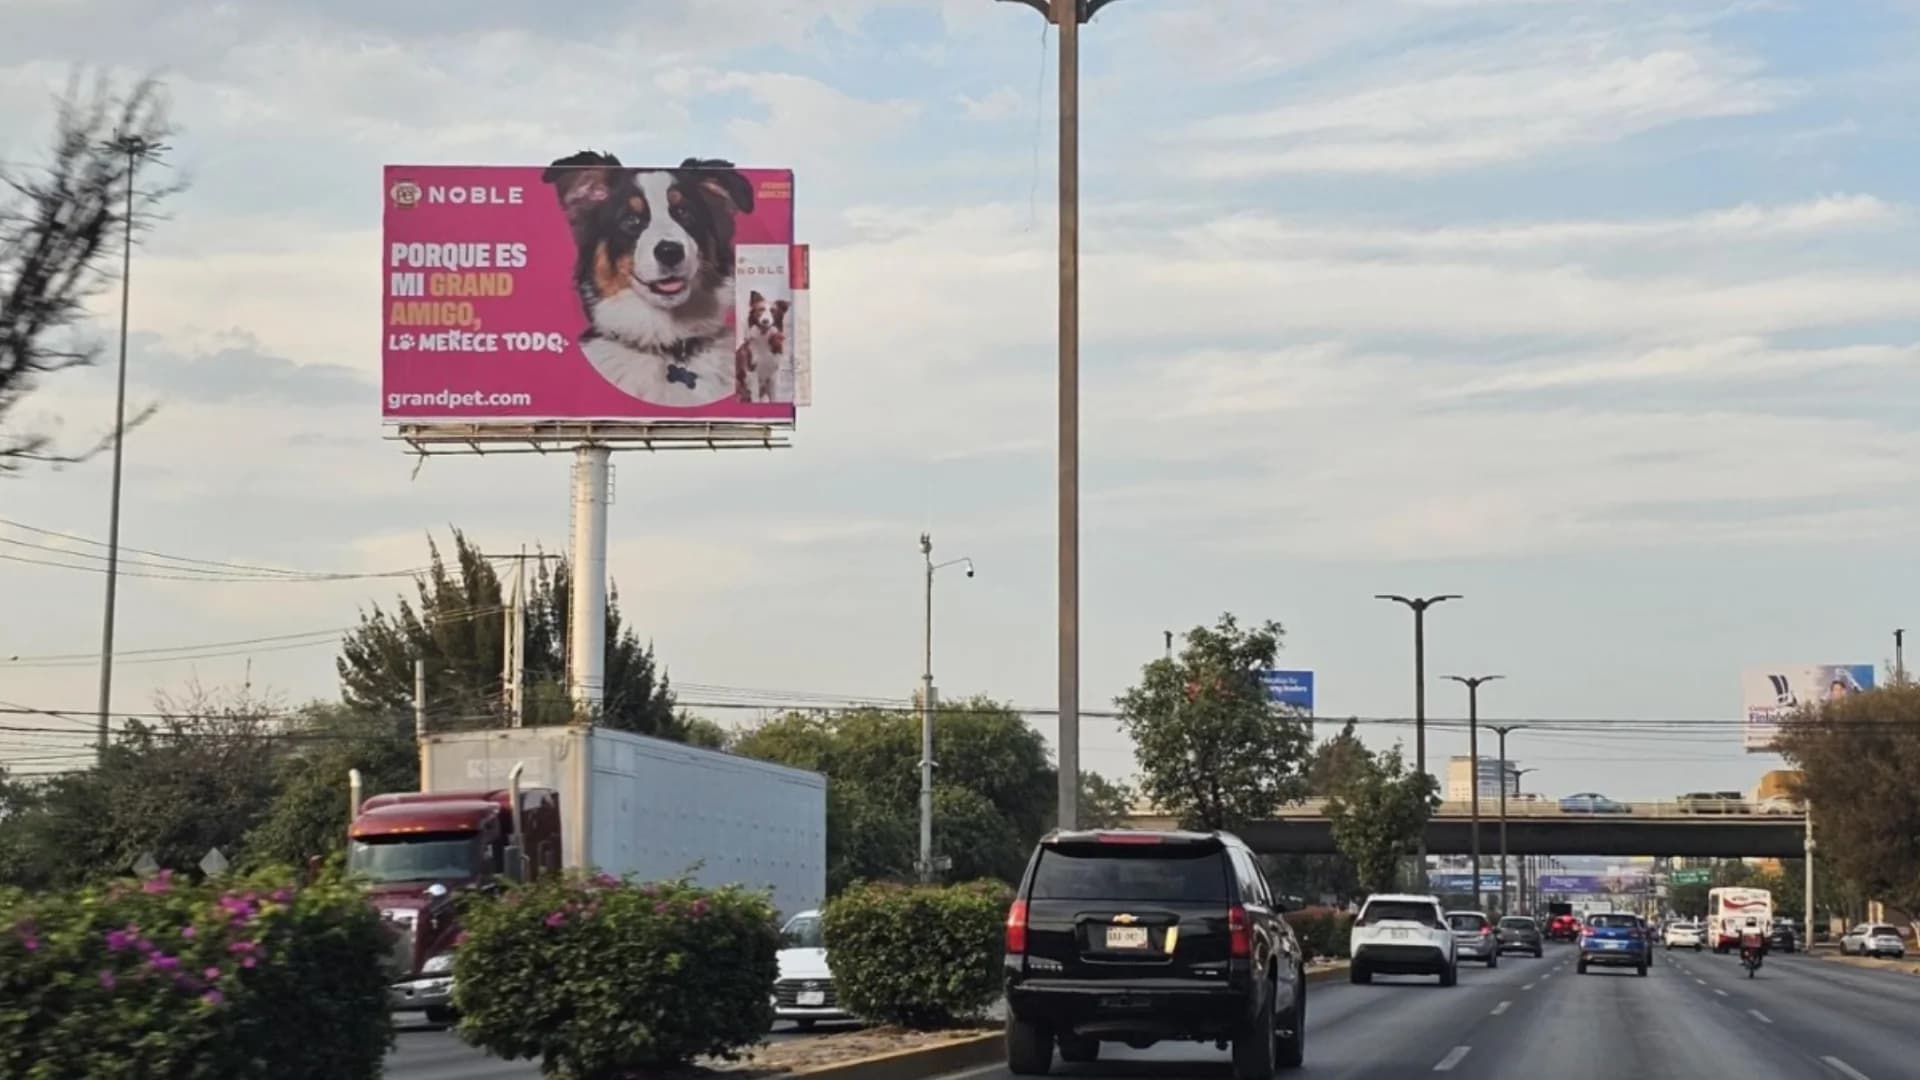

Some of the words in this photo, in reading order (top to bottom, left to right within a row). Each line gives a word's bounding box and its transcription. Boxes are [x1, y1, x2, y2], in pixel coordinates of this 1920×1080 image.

[428, 186, 524, 204] NOBLE
[391, 242, 491, 271] PORQUE
[496, 243, 527, 268] ES
[736, 265, 785, 275] NOBLE
[391, 272, 425, 296] MI
[429, 273, 514, 297] GRAND
[389, 301, 482, 331] AMIGO,
[418, 329, 499, 352] MERECE
[387, 389, 532, 409] grandpet.com
